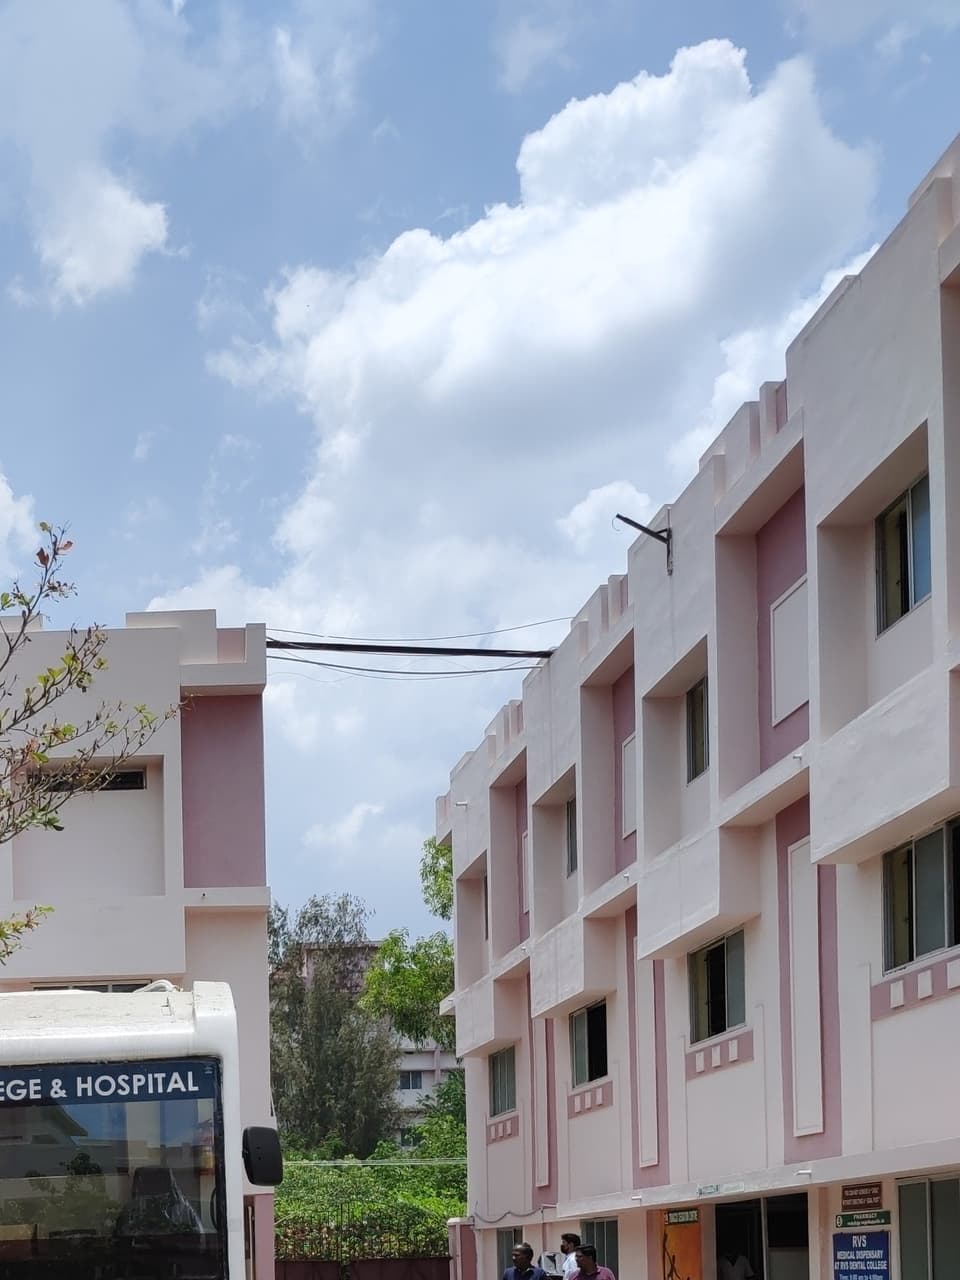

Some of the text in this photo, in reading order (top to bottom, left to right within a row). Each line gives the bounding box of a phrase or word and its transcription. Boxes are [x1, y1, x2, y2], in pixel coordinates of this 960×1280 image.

[49, 1078, 67, 1098] &
[76, 1071, 199, 1097] HOSPITAL
[852, 1234, 867, 1248] RVS
[837, 1250, 884, 1260] MEDICAL DISPENSARY
[849, 1261, 866, 1270] DENTAL
[866, 1260, 888, 1270] COLLEGE
